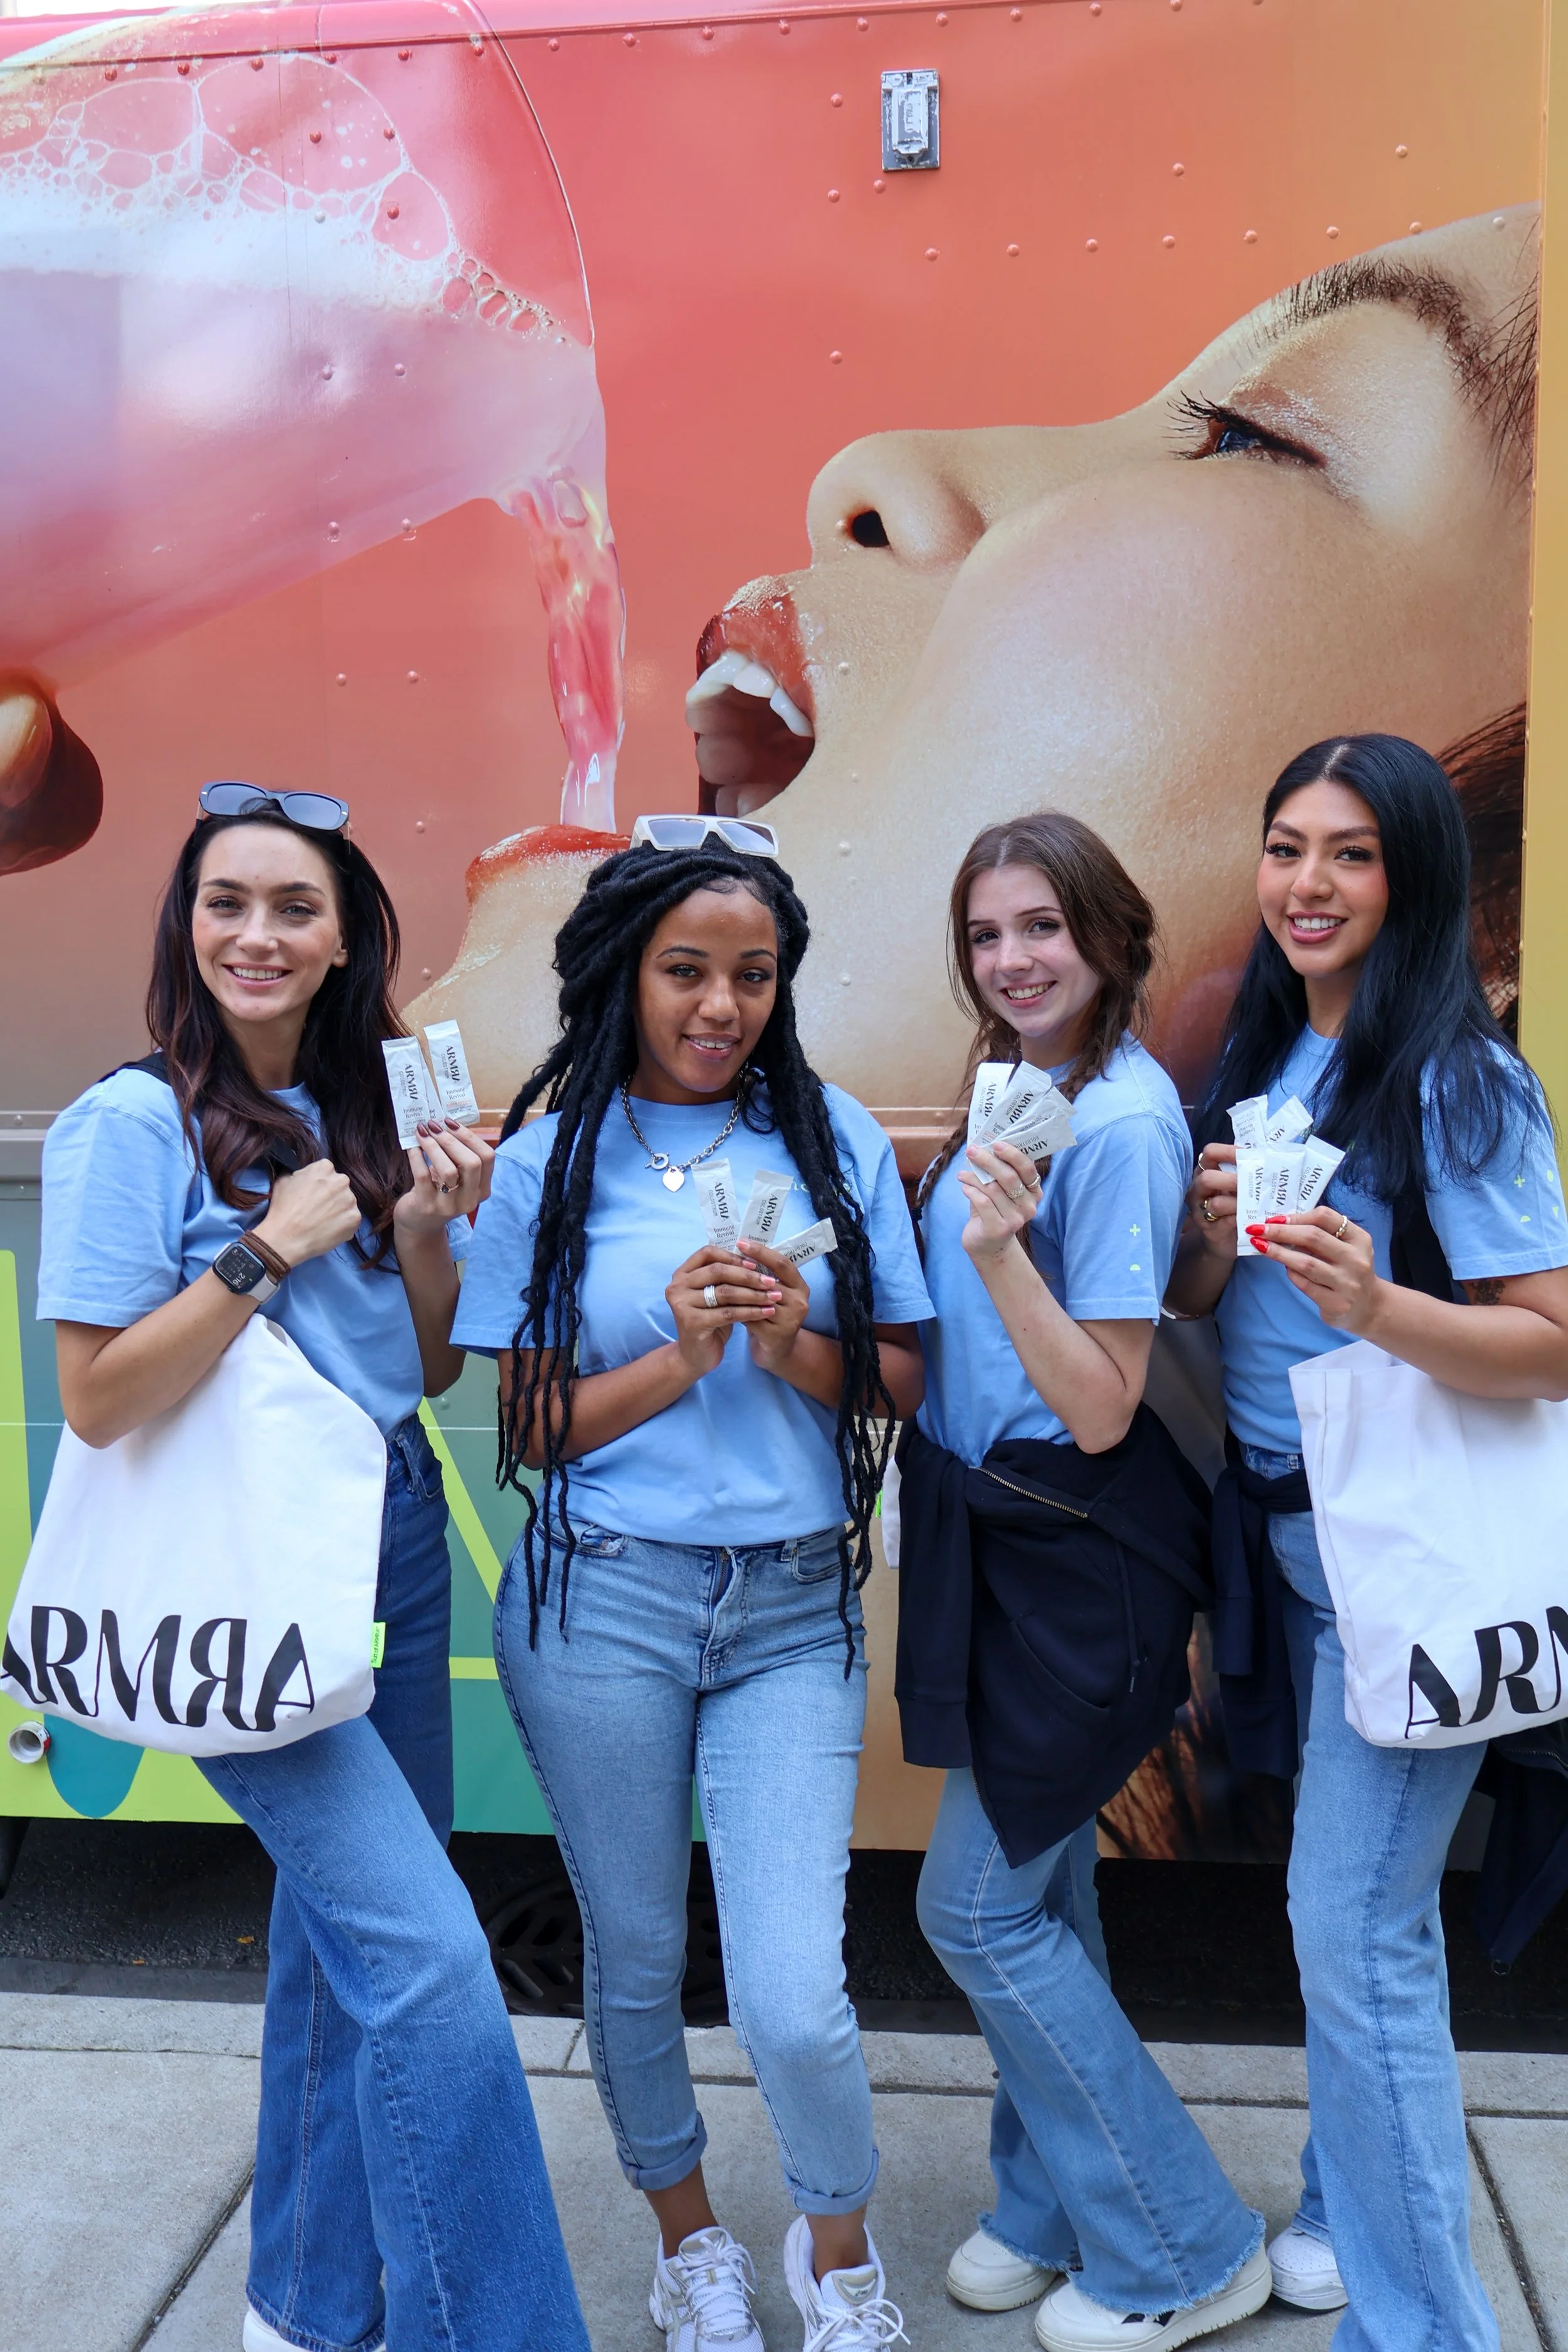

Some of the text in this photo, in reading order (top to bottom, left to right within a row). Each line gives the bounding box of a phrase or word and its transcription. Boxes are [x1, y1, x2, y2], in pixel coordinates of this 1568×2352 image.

[446, 1045, 461, 1084] ARMRA
[404, 1063, 418, 1102] ARMRA
[403, 1106, 423, 1114] Immune
[1005, 1092, 1022, 1116] COLOSTRUM
[1006, 1089, 1034, 1125] ARMRA
[1020, 1138, 1048, 1155] ARM
[1269, 1172, 1278, 1200] COLOSTRUM
[1276, 1165, 1290, 1207] ARMRA
[1298, 1163, 1323, 1200] ARMRA
[714, 1180, 729, 1222] ARMRA
[756, 1199, 766, 1225] COLOSTRUM
[760, 1194, 778, 1233] ARMRA
[714, 1224, 735, 1232] Immune
[716, 1230, 734, 1239] Revival
[748, 1234, 768, 1243] Immune
[790, 1243, 815, 1263] ARM
